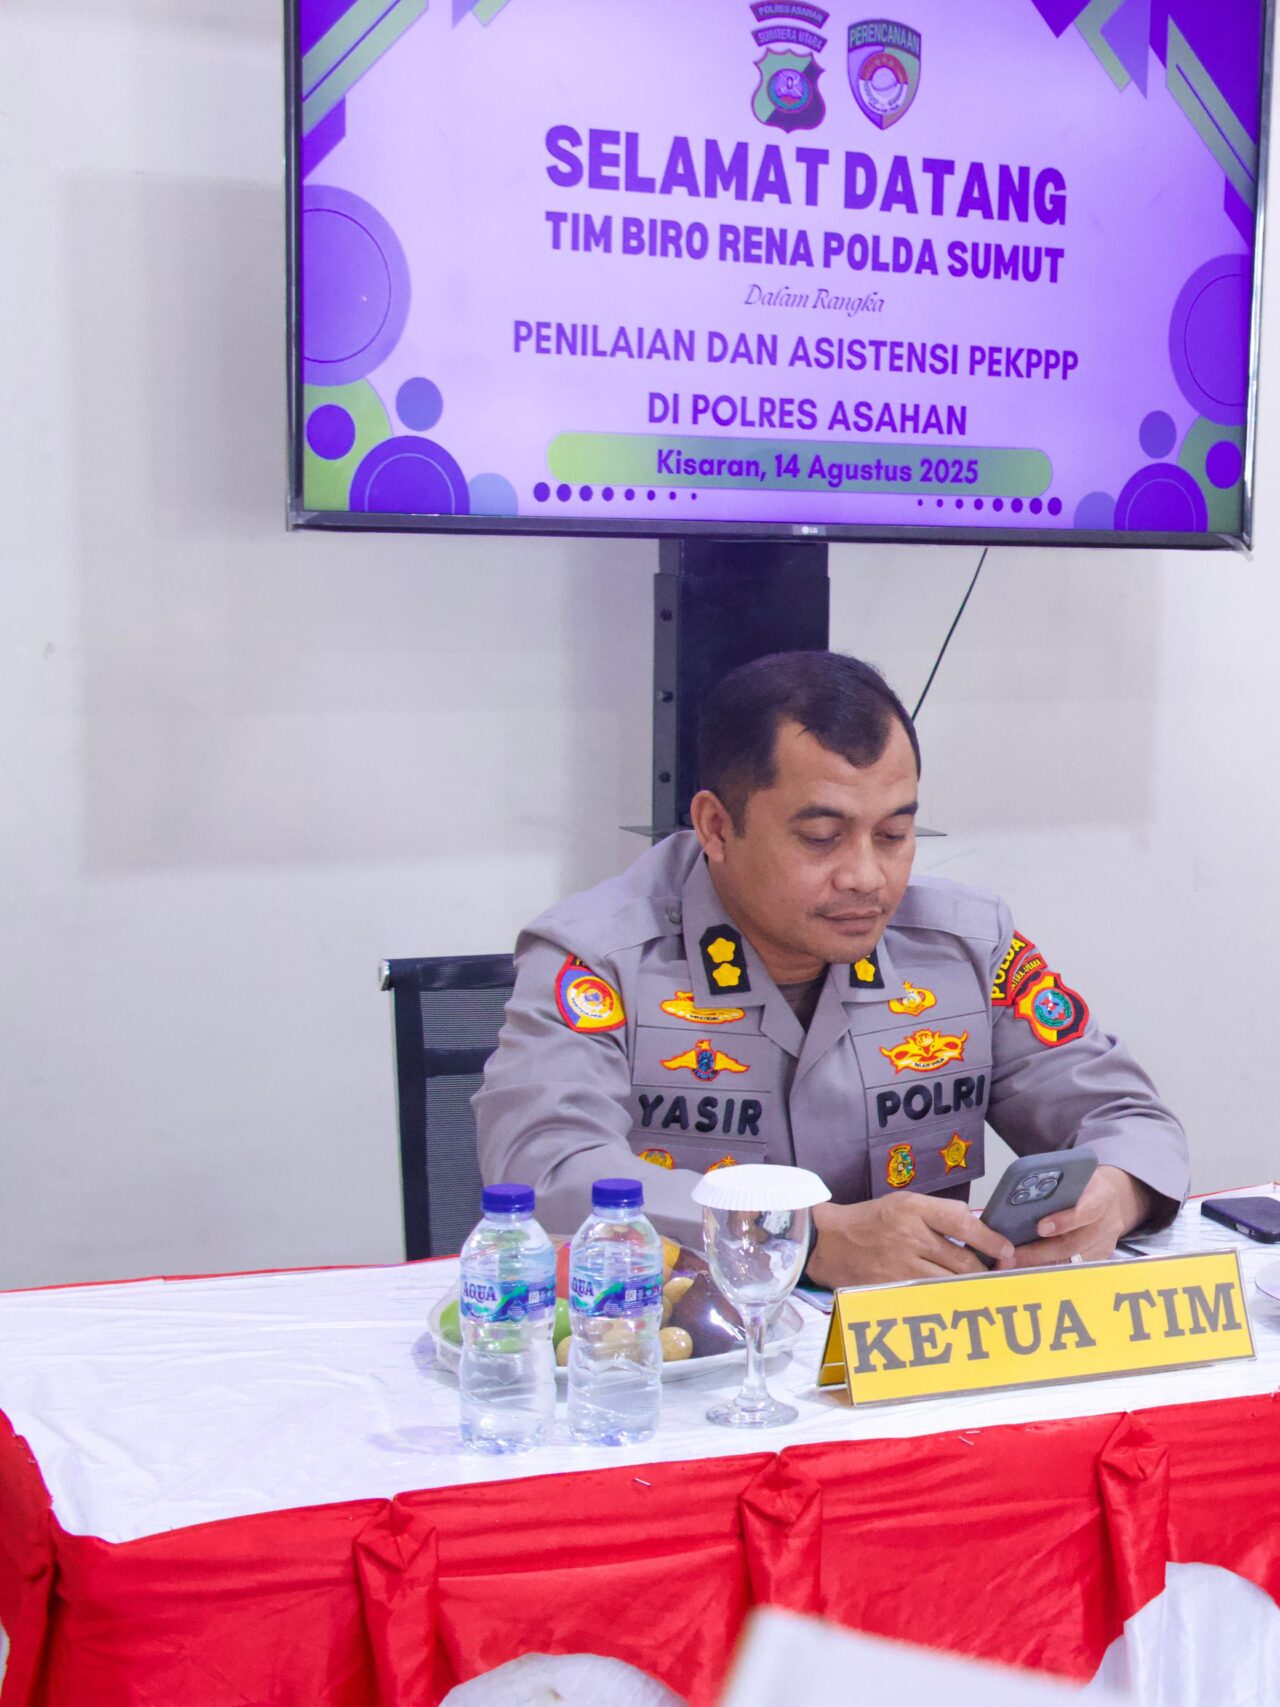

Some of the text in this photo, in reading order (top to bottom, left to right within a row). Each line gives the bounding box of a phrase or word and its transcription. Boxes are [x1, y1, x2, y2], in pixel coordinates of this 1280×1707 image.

[849, 23, 919, 55] PERENCANAAN
[545, 125, 1067, 226] SELAMAT DATANG
[545, 211, 1065, 284] TIM BIRO RENA POLDA SUMUT
[743, 283, 886, 317] Dalam Rangka
[514, 320, 1080, 381] PENILAIAN DAN ASISTENSI PEKPPP
[648, 392, 967, 436] DI POLRES ASAHAN
[657, 449, 979, 489] Kisaran, 14 Agustus 2025
[638, 1094, 763, 1136] YASIR
[876, 1074, 986, 1129] POLRI
[463, 1281, 498, 1304] AQUA
[847, 1281, 1243, 1374] KETUA TIM
